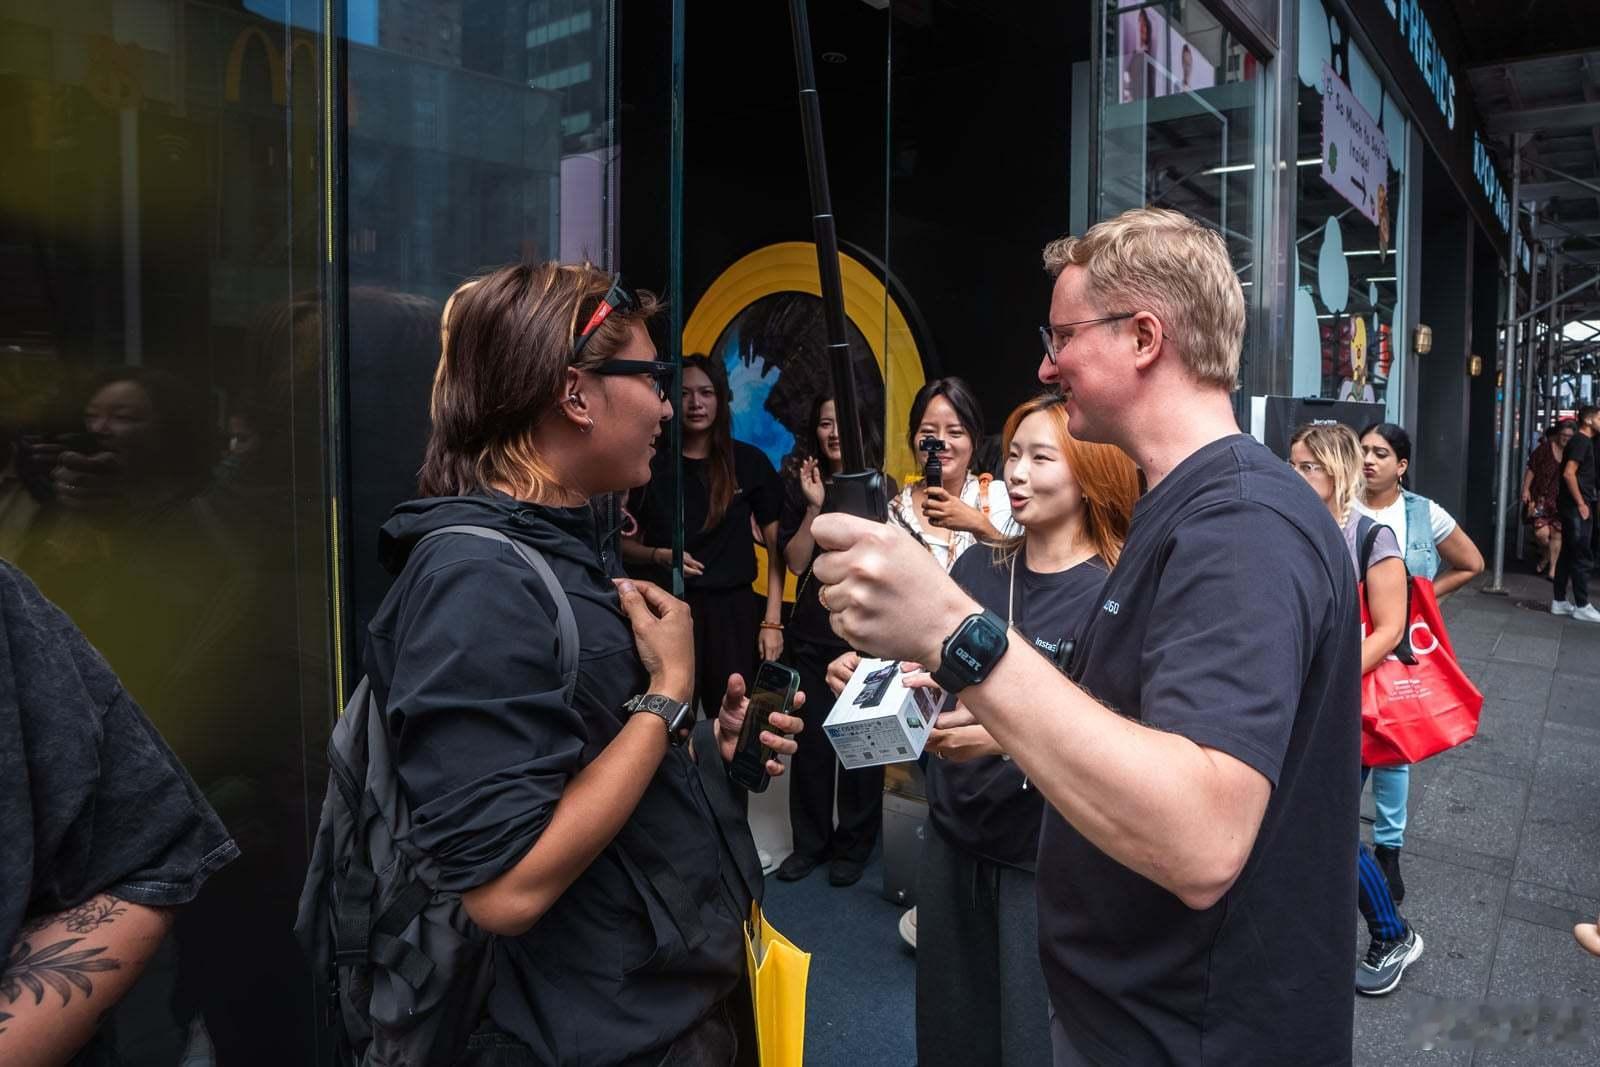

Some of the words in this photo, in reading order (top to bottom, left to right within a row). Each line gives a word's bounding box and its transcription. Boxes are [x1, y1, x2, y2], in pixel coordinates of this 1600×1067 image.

[1399, 0, 1455, 131] FRIENDS
[1336, 92, 1344, 116] So
[1346, 104, 1363, 139] Much
[1364, 125, 1370, 146] to
